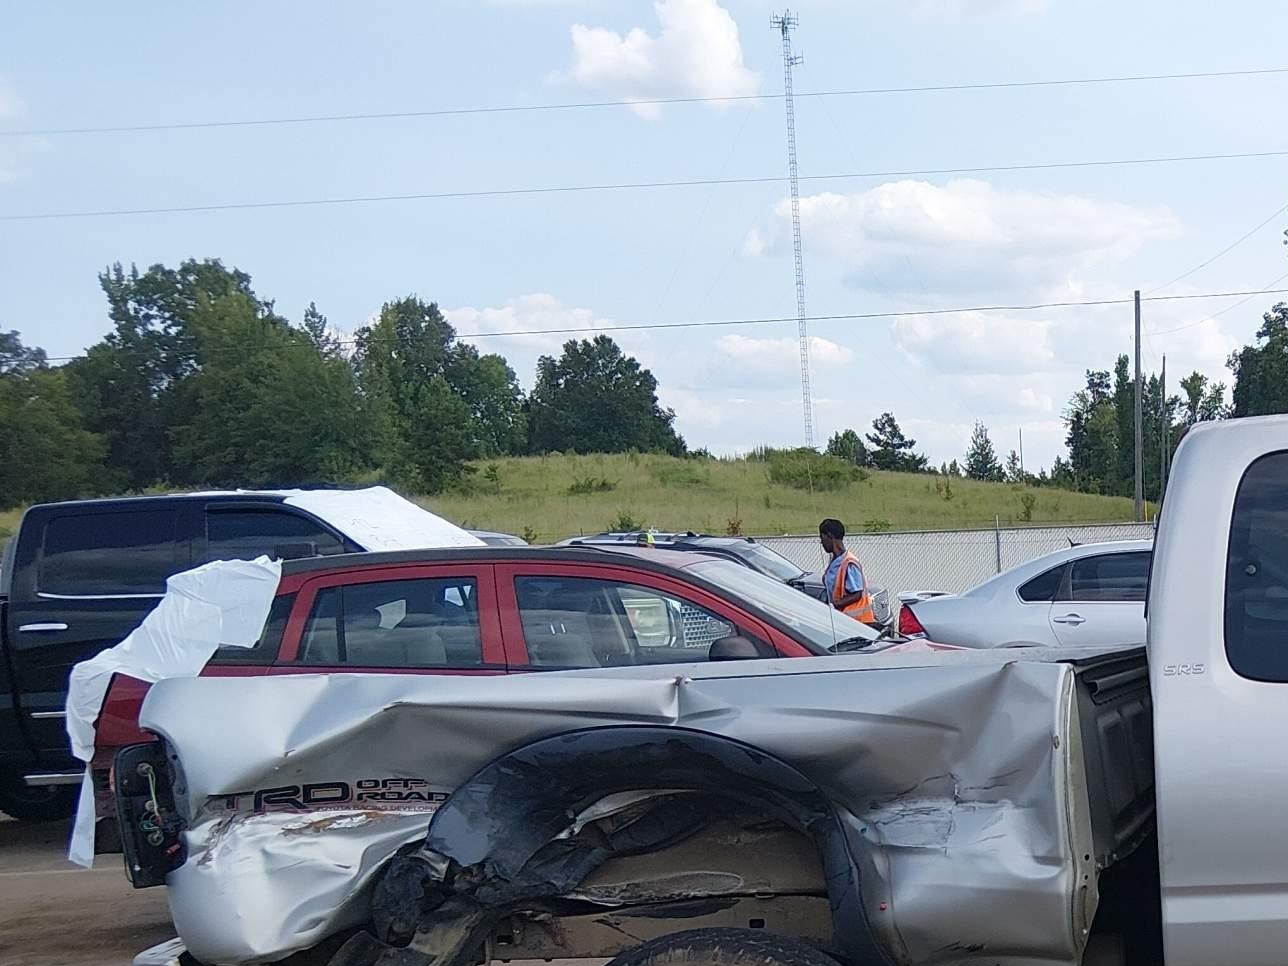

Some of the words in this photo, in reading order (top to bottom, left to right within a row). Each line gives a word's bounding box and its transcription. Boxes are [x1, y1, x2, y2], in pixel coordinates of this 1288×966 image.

[1163, 663, 1206, 676] SRS
[356, 778, 428, 790] OFF
[206, 781, 353, 814] TRD
[356, 791, 450, 802] ROAD
